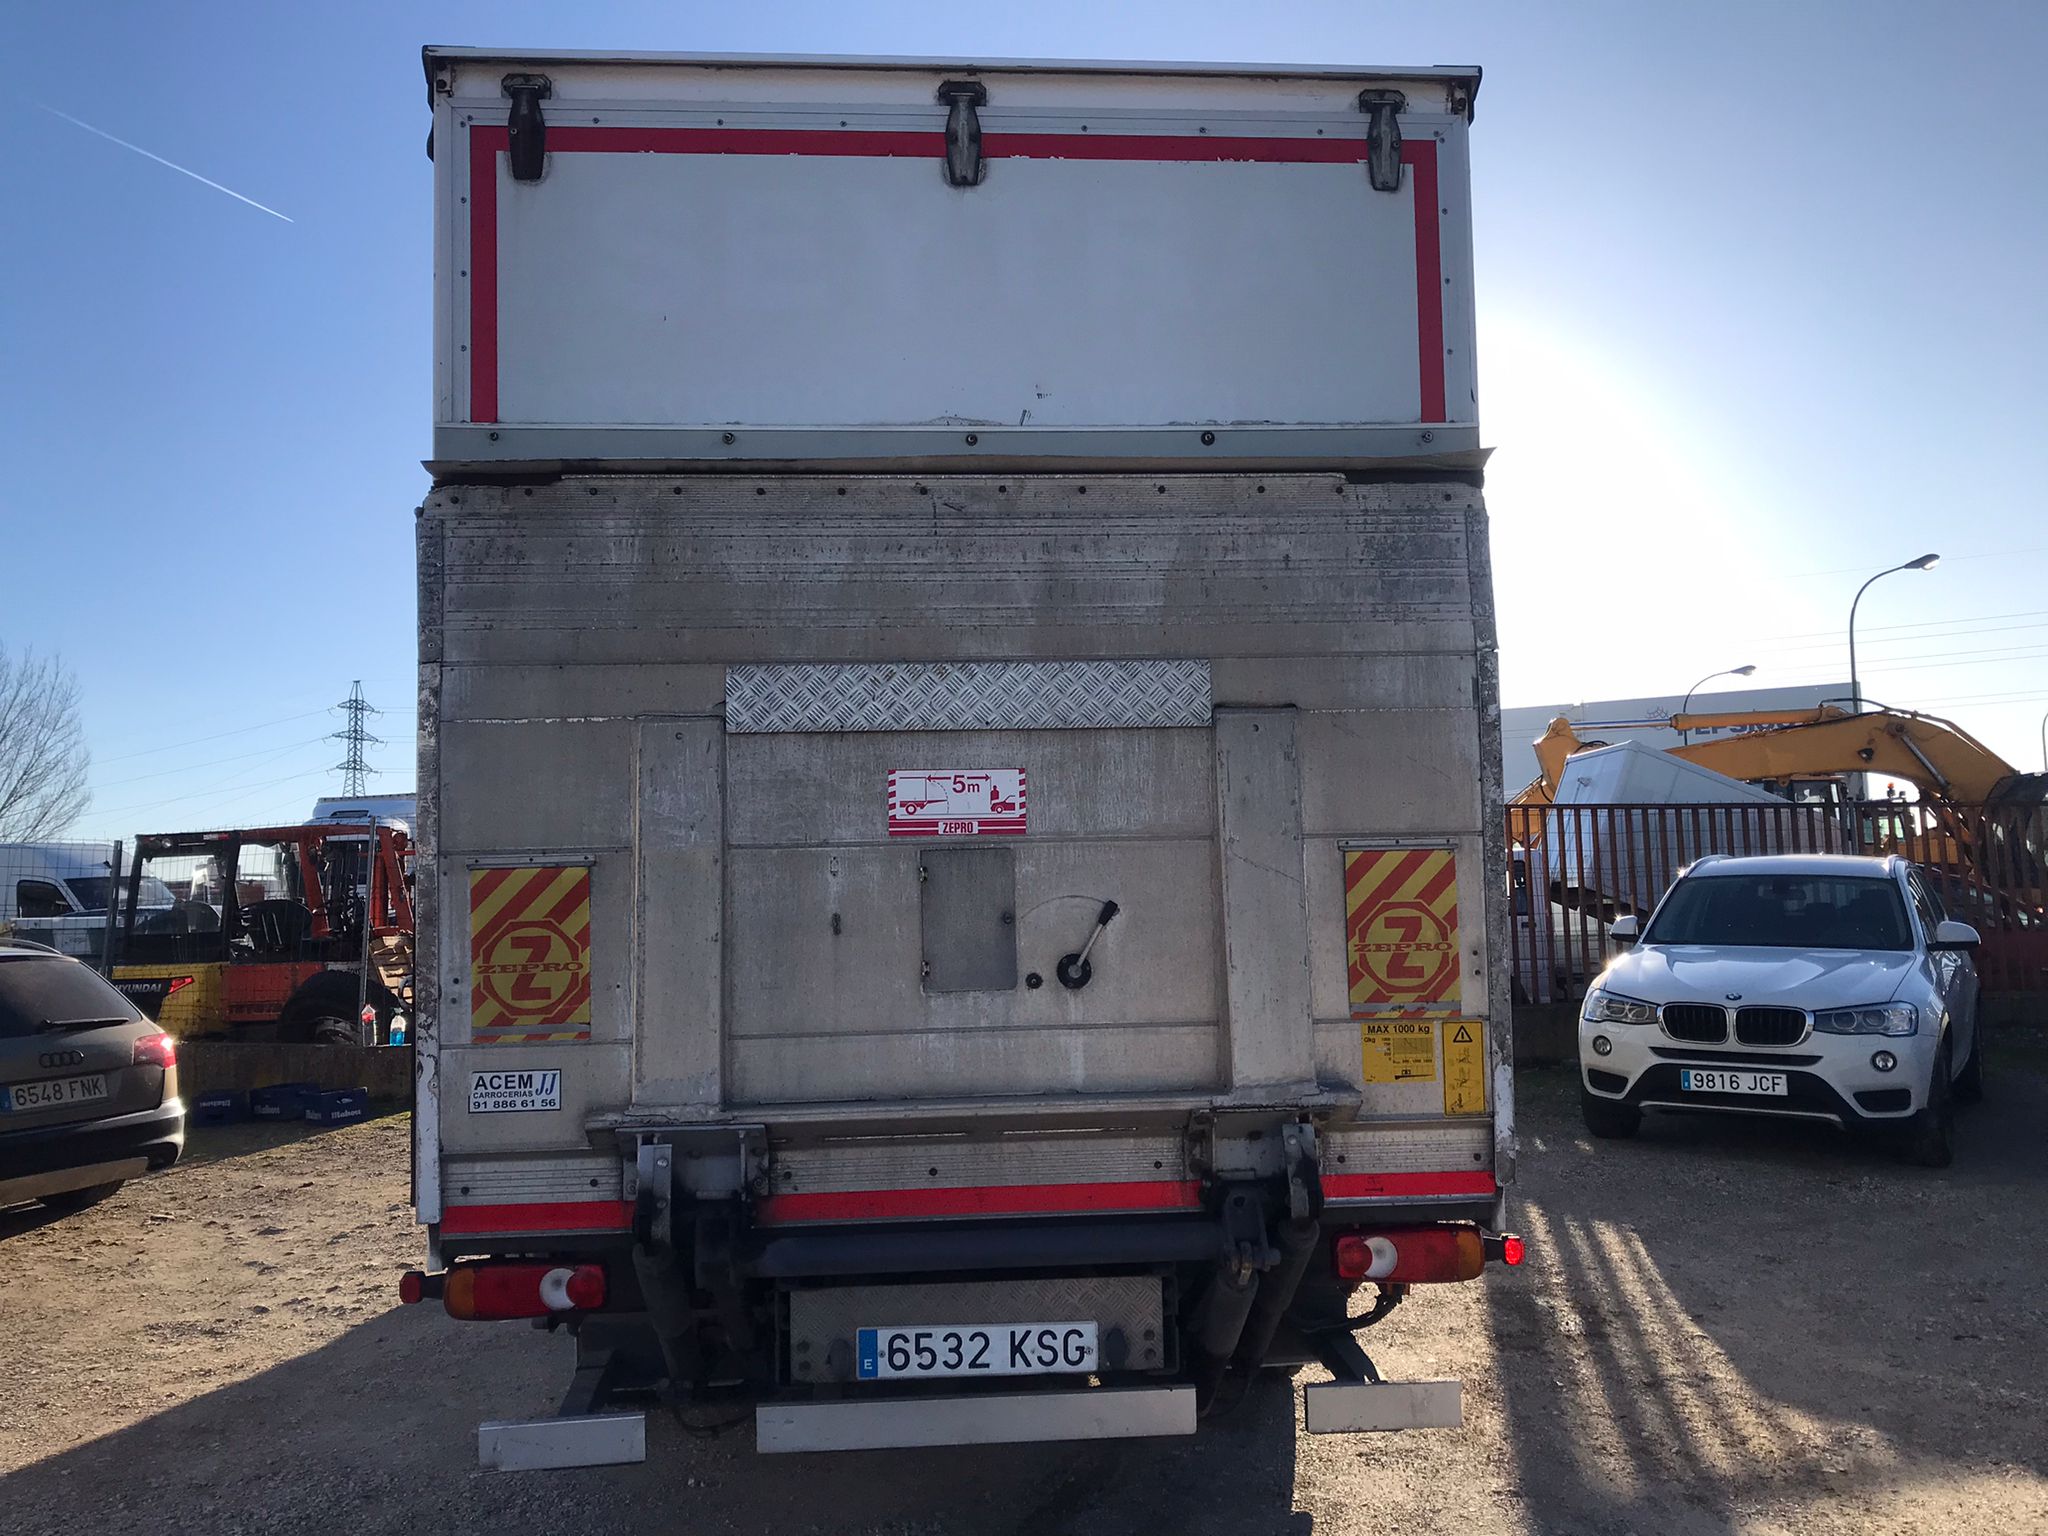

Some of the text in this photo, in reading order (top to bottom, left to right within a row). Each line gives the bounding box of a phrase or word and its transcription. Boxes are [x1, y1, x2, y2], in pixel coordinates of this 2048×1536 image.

[942, 822, 974, 834] ZEPRO
[1353, 942, 1453, 953] ZEPRO
[477, 961, 584, 975] ZEPRO
[115, 983, 162, 993] HYUNDAI
[1367, 1024, 1430, 1035] MAX 1000 kg
[474, 1072, 559, 1097] ACEM JJ
[1693, 1073, 1783, 1093] 9816 JCF
[15, 1077, 103, 1106] 6548 FNK
[473, 1090, 534, 1099] CARROCERIAS
[473, 1098, 556, 1110] 91 886 61 56
[886, 1329, 1086, 1372] 6532 KSG
[863, 1359, 873, 1370] E
